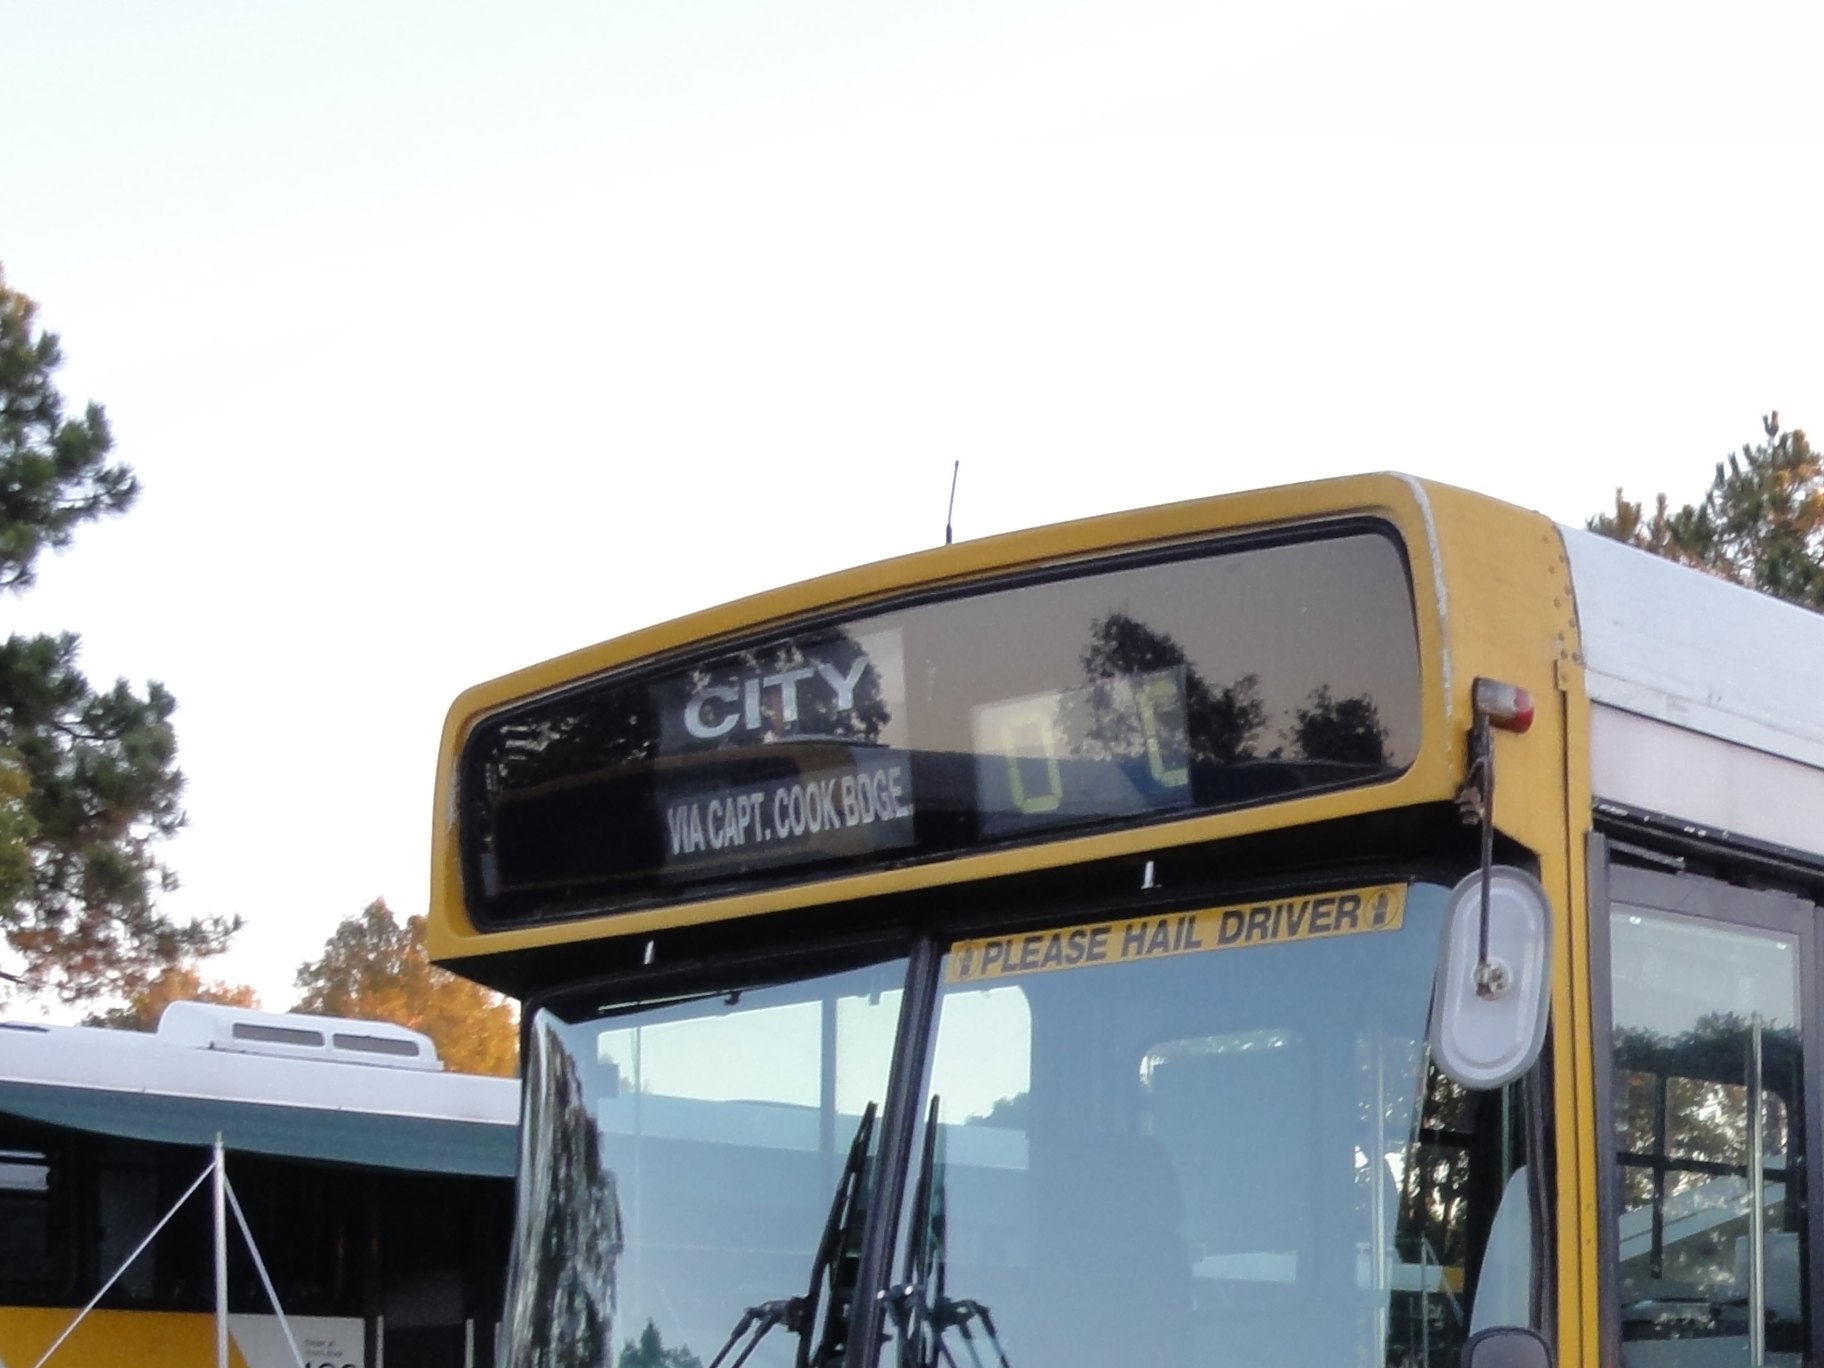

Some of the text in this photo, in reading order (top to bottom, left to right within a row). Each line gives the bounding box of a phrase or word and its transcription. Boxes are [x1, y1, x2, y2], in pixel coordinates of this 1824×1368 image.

[684, 656, 869, 738] CITY
[667, 804, 706, 855] VIA
[706, 792, 771, 850] CAPT.
[774, 777, 841, 839] COOK
[979, 894, 1361, 975] PLEASE HAIL DRIVER
